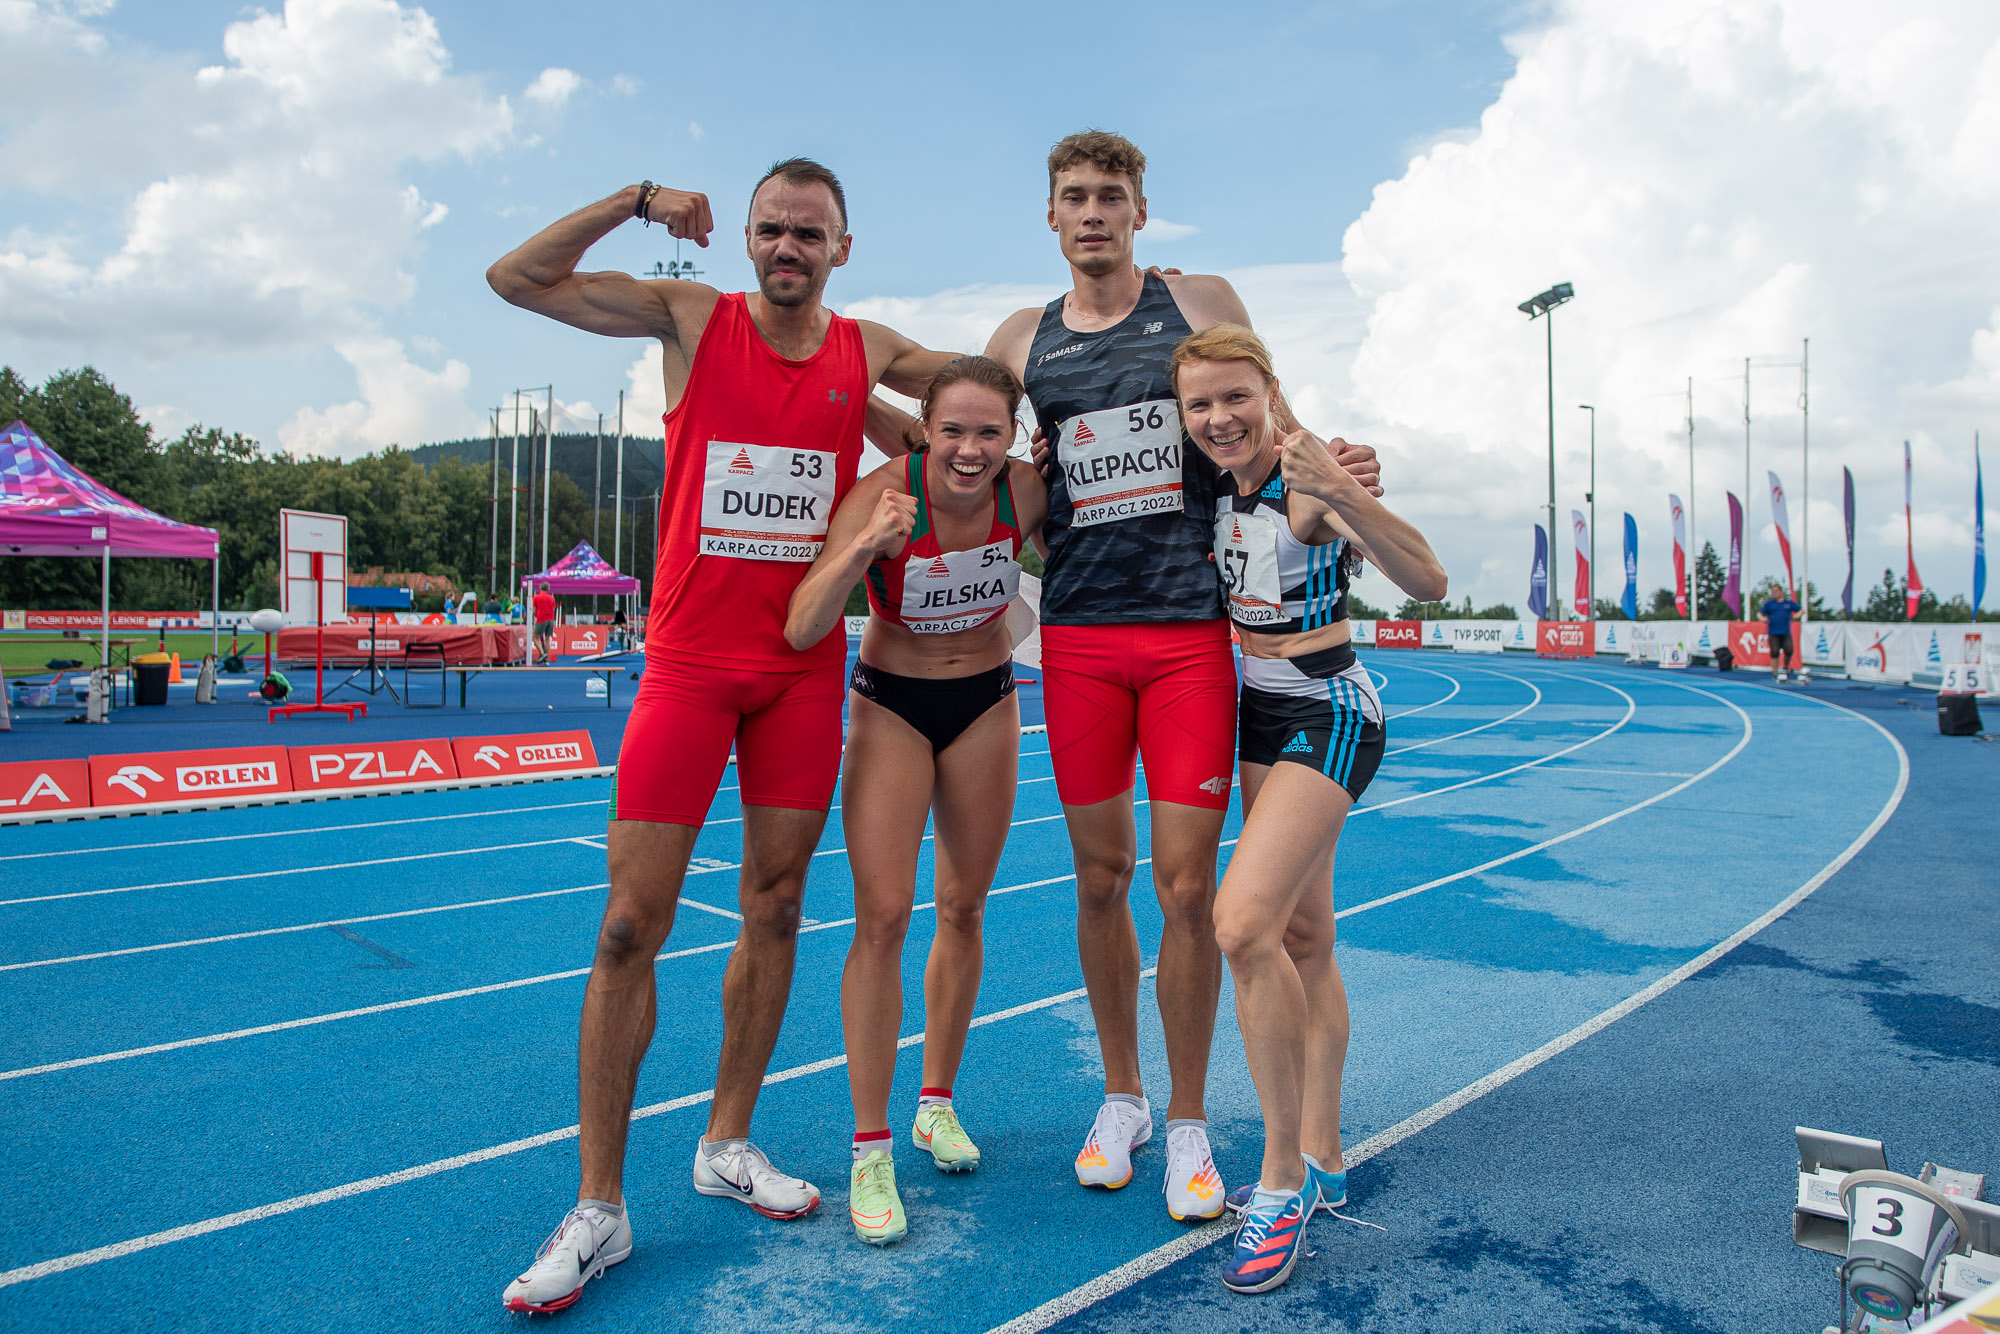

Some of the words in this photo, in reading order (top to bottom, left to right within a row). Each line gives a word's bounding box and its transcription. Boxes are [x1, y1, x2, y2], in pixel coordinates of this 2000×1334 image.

[1128, 405, 1163, 432] 56
[1073, 438, 1096, 447] KARPACZ
[790, 453, 822, 478] 53
[1066, 444, 1180, 488] KLEPACKI
[1140, 495, 1175, 511] 2022
[1261, 490, 1282, 499] adidas
[722, 489, 817, 520] DUDEK
[706, 540, 778, 557] KARPACZ
[781, 545, 812, 558] 2022
[1224, 548, 1249, 593] 57
[918, 578, 1006, 609] JELSKA
[1244, 609, 1274, 622] 2022
[1454, 629, 1472, 641] TVP
[1473, 629, 1501, 641] SPORT
[1671, 650, 1680, 661] 6
[1966, 671, 1978, 688] 5
[521, 745, 578, 762] ORLEN
[1281, 743, 1314, 753] adidas
[308, 748, 443, 784] PZLA
[183, 766, 270, 787] ORLEN
[1871, 1197, 1904, 1237] 3
